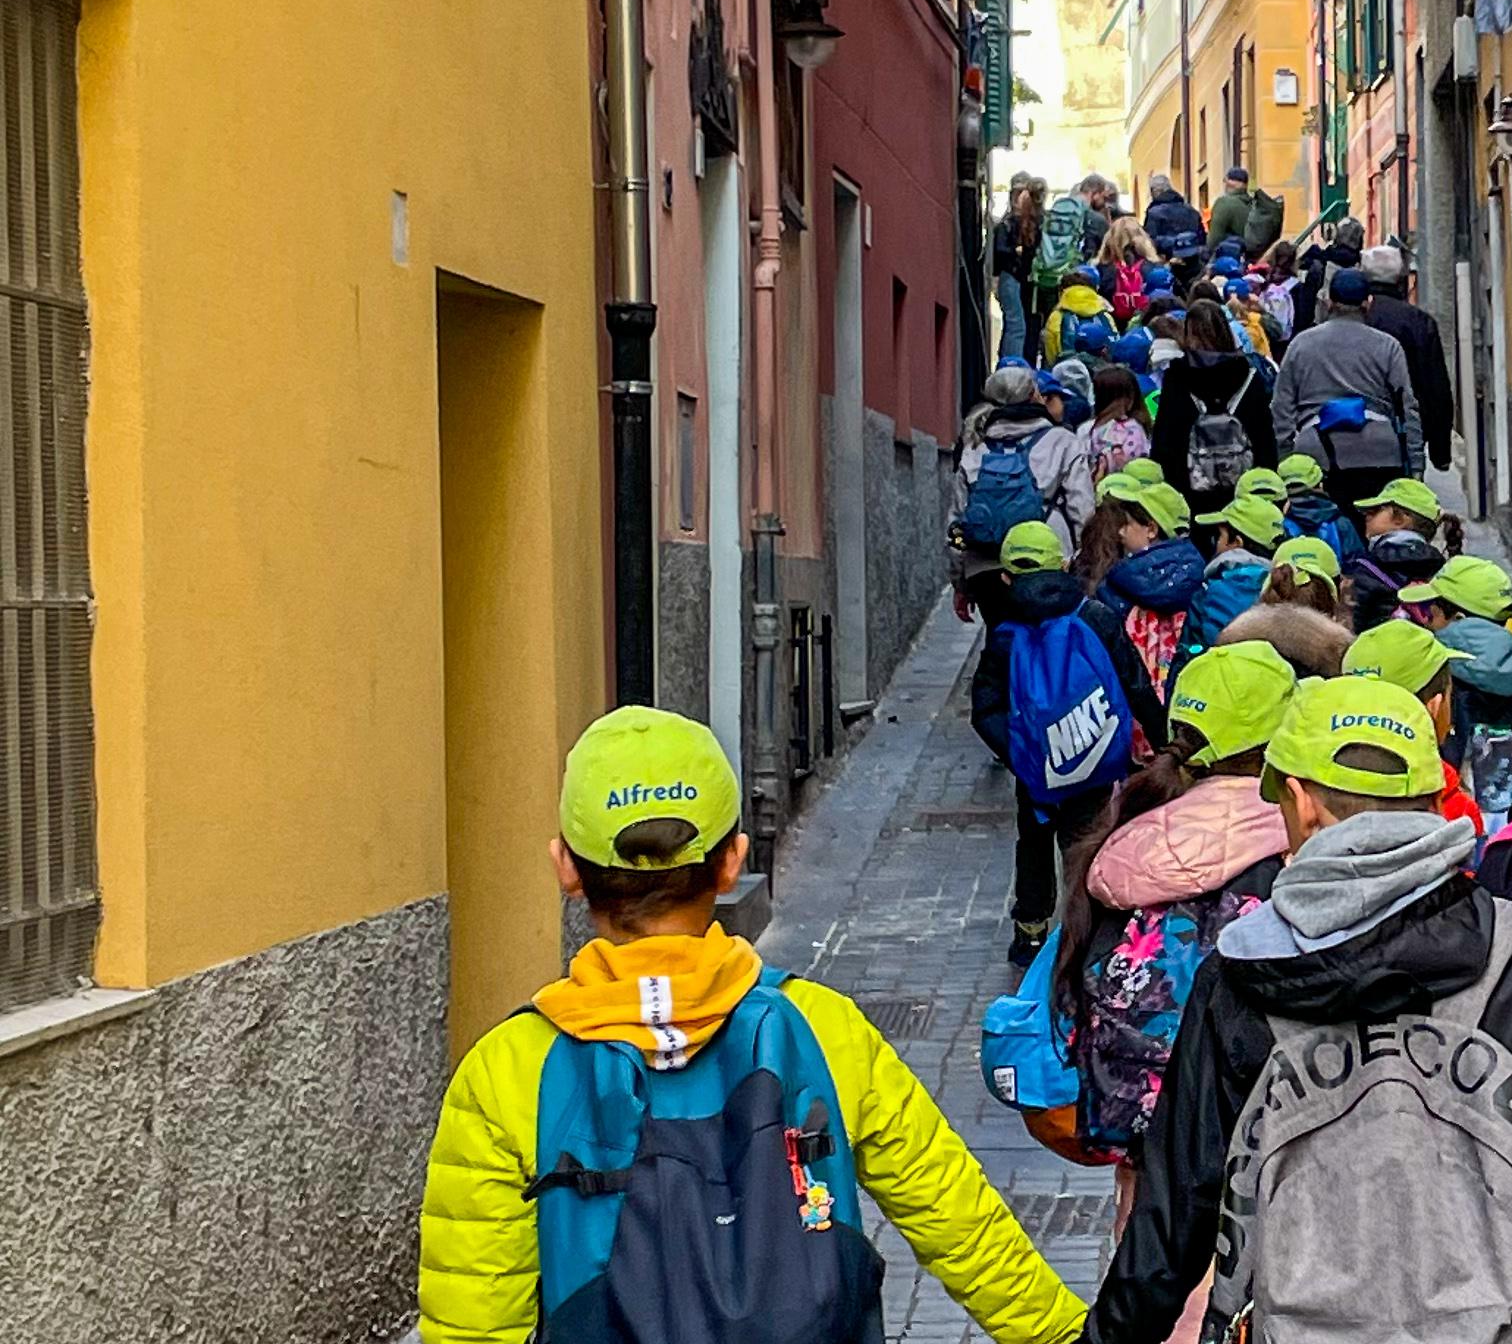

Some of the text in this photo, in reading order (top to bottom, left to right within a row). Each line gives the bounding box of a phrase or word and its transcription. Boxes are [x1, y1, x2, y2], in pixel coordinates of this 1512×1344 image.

[1046, 685, 1110, 768] NIKE
[1330, 713, 1416, 741] Lorenzo
[605, 781, 698, 810] Alfredo
